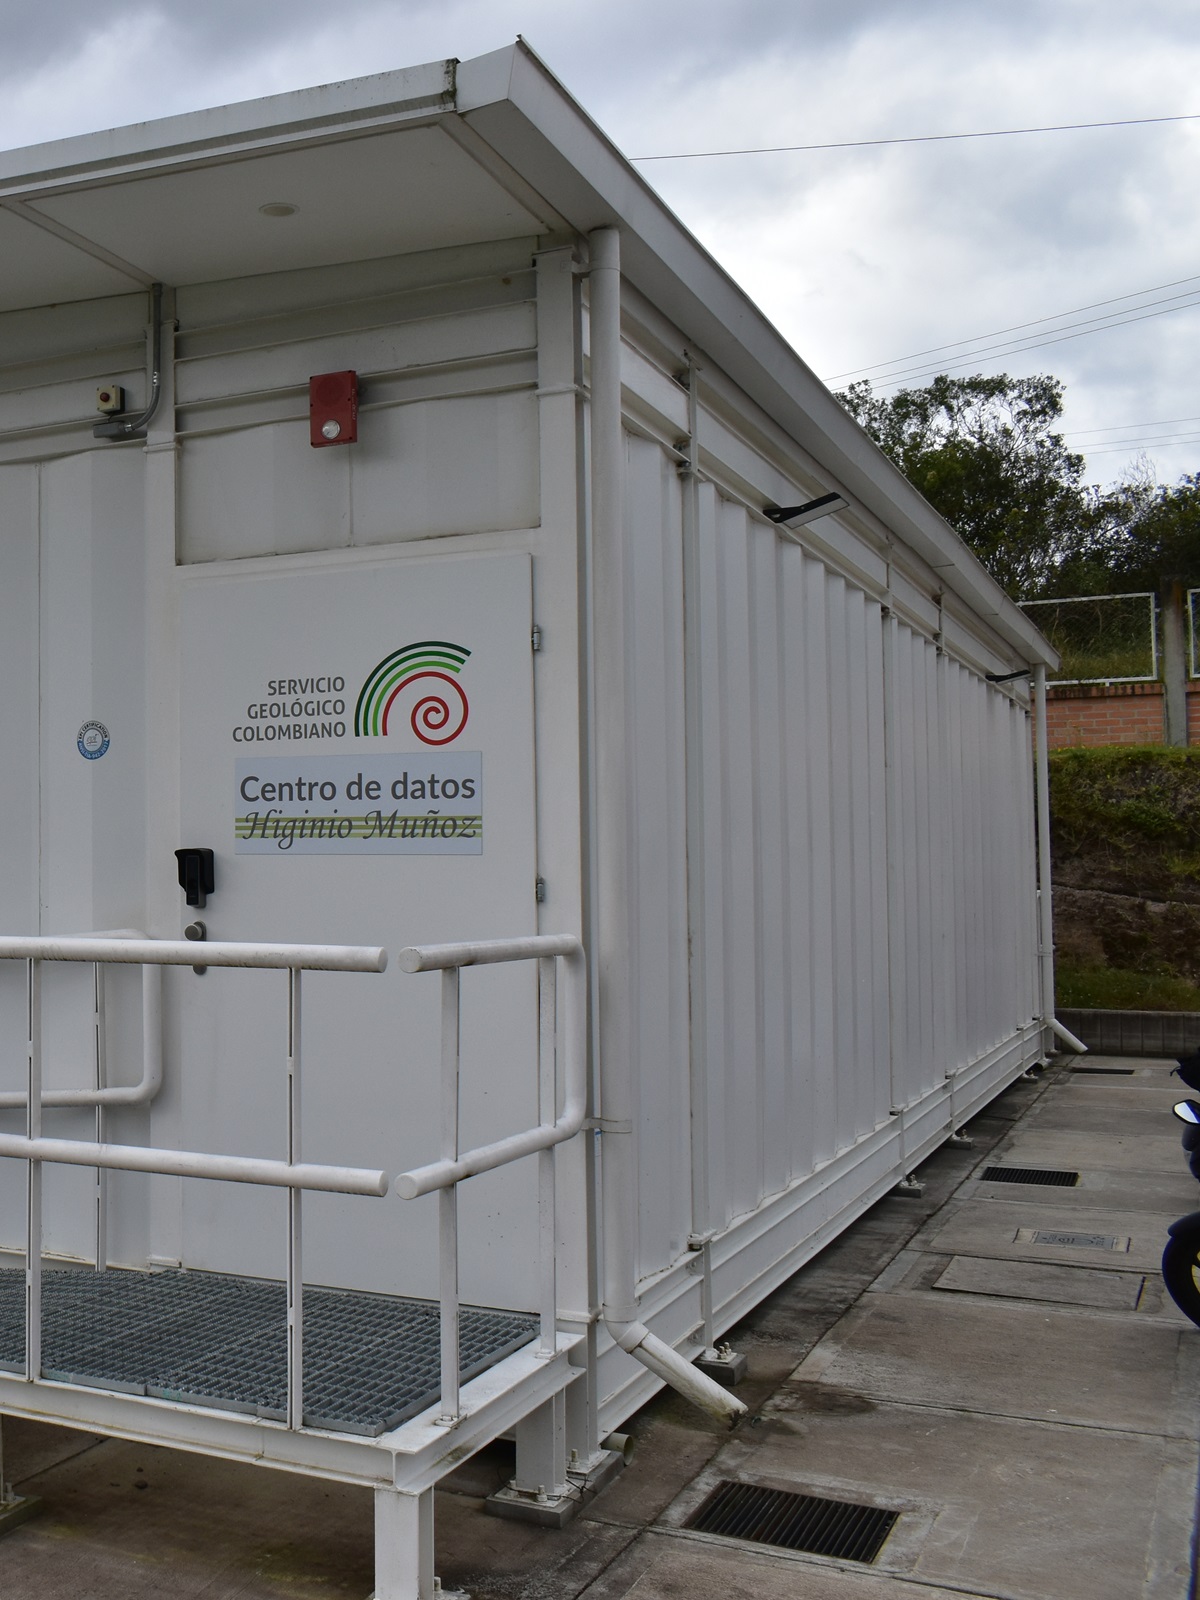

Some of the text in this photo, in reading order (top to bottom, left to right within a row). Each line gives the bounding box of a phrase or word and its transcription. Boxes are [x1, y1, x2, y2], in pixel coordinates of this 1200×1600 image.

[267, 676, 345, 696] SERVICIO
[247, 698, 346, 719] GEOLÓGICO
[232, 721, 346, 743] COLOMBIANO
[240, 771, 476, 802] Centro de datos
[242, 809, 478, 850] Higinio Muñoz
